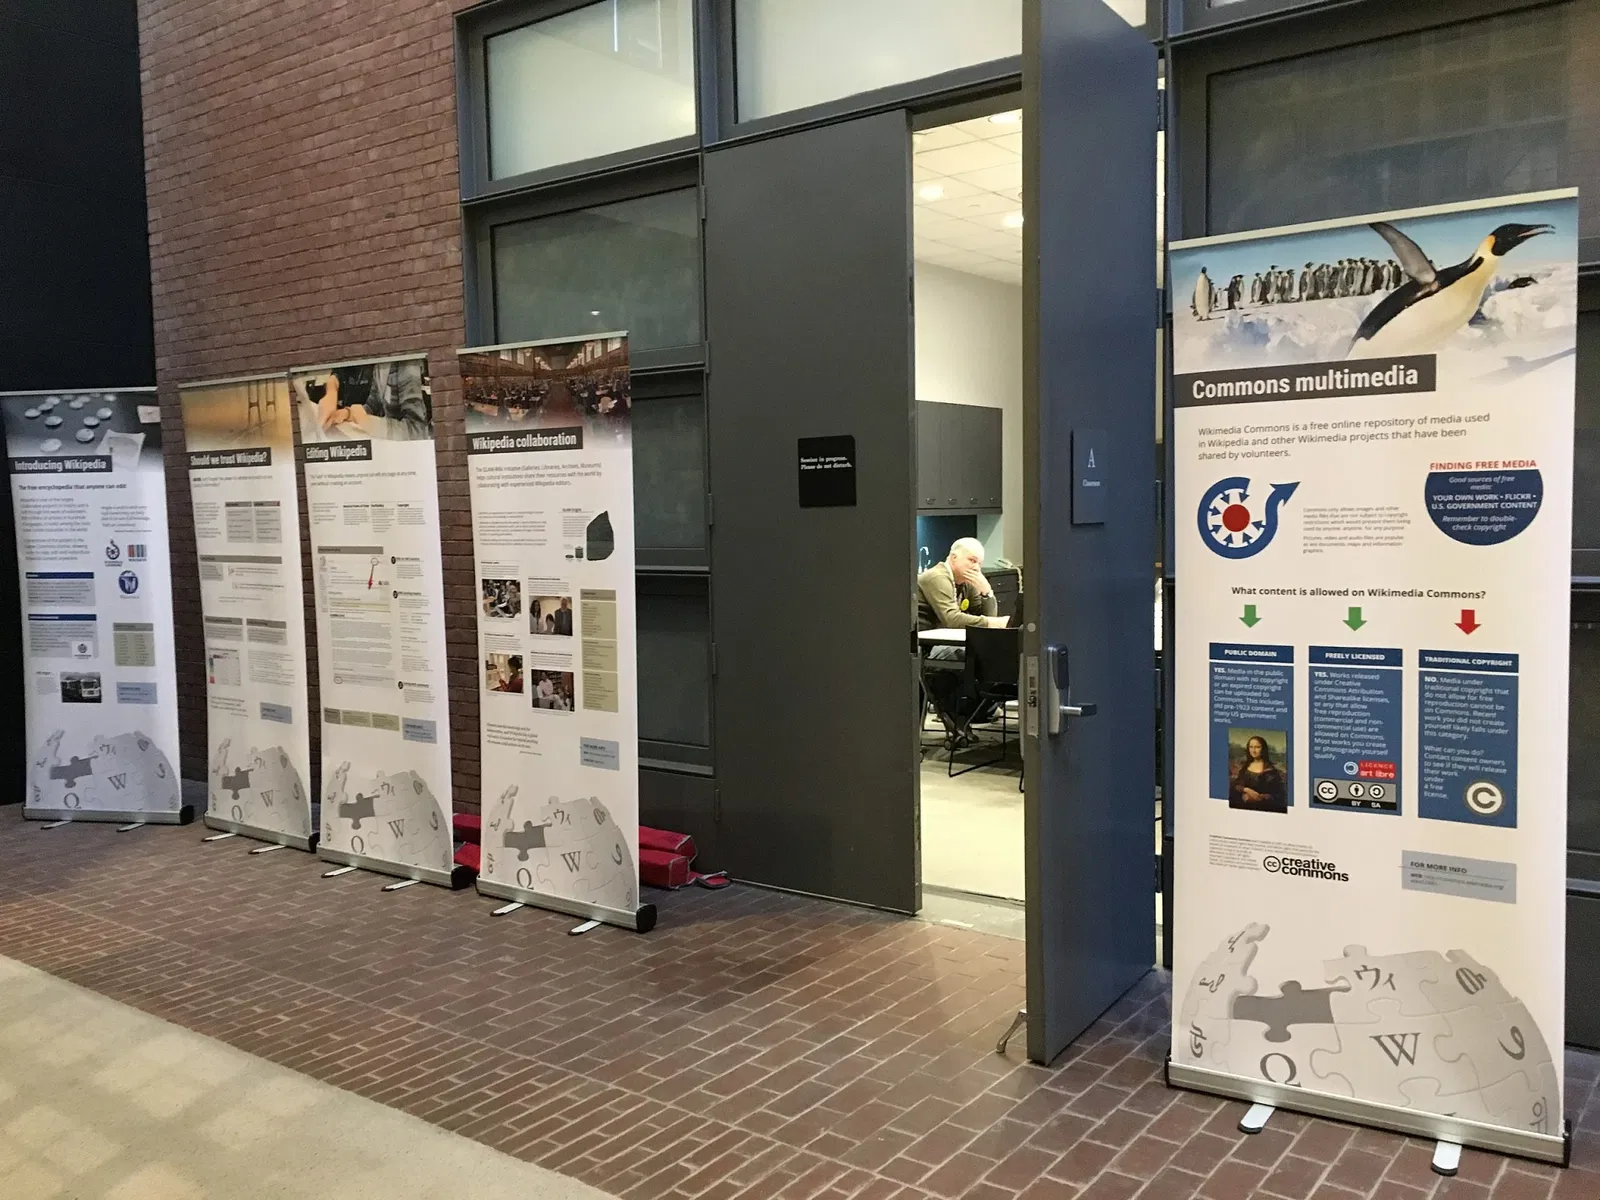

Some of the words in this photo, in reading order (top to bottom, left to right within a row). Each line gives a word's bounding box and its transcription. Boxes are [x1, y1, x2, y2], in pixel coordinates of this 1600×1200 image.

[1193, 377, 1290, 399] Commons
[1296, 365, 1418, 392] multimedia
[1198, 426, 1241, 436] Wikimedia
[1244, 424, 1290, 434] Commons
[1293, 423, 1299, 432] is
[1310, 422, 1329, 430] free
[1331, 420, 1361, 429] online
[1364, 418, 1415, 429] repository
[1418, 416, 1428, 425] of
[1430, 415, 1462, 424] media
[1465, 413, 1490, 423] used
[472, 436, 514, 452] Wikipedia
[516, 433, 577, 448] collaboration
[1198, 440, 1206, 448] in
[1208, 438, 1249, 449] Wikipedia
[1252, 437, 1269, 446] and
[1271, 436, 1295, 444] other
[1298, 434, 1347, 443] Wikimedia
[1350, 432, 1389, 443] projects
[1392, 431, 1412, 439] that
[1415, 430, 1438, 438] have
[1441, 428, 1467, 437] been
[191, 454, 210, 466] Should
[221, 454, 236, 464] trust
[236, 452, 267, 465] Wikipedia?
[306, 447, 329, 460] Editing
[330, 445, 367, 460] Wikipedia
[1088, 448, 1096, 468] A
[1198, 452, 1226, 460] shared
[1229, 451, 1239, 460] by
[1241, 450, 1291, 458] volunteers.
[15, 460, 62, 472] Introducing
[64, 459, 107, 471] Wikipedia
[1430, 462, 1472, 470] FINDING
[1476, 461, 1499, 469] FREE
[1503, 460, 1537, 468] MEDIA
[1474, 524, 1507, 532] copyright
[1232, 587, 1257, 595] What
[1259, 588, 1297, 596] content
[1300, 588, 1307, 596] is
[1310, 588, 1349, 596] allowed
[1368, 589, 1424, 597] Wikimedia
[1427, 590, 1486, 599] Commons?
[1314, 686, 1347, 694] Commons
[1435, 708, 1471, 716] Commons.
[108, 773, 127, 790] W
[1376, 771, 1394, 779] libre
[388, 819, 405, 839] W
[561, 851, 582, 874] W
[1282, 858, 1336, 871] creative
[1427, 863, 1447, 871] MORE
[1449, 866, 1468, 874] INFO
[1282, 866, 1349, 882] commons
[1370, 1032, 1422, 1068] W
